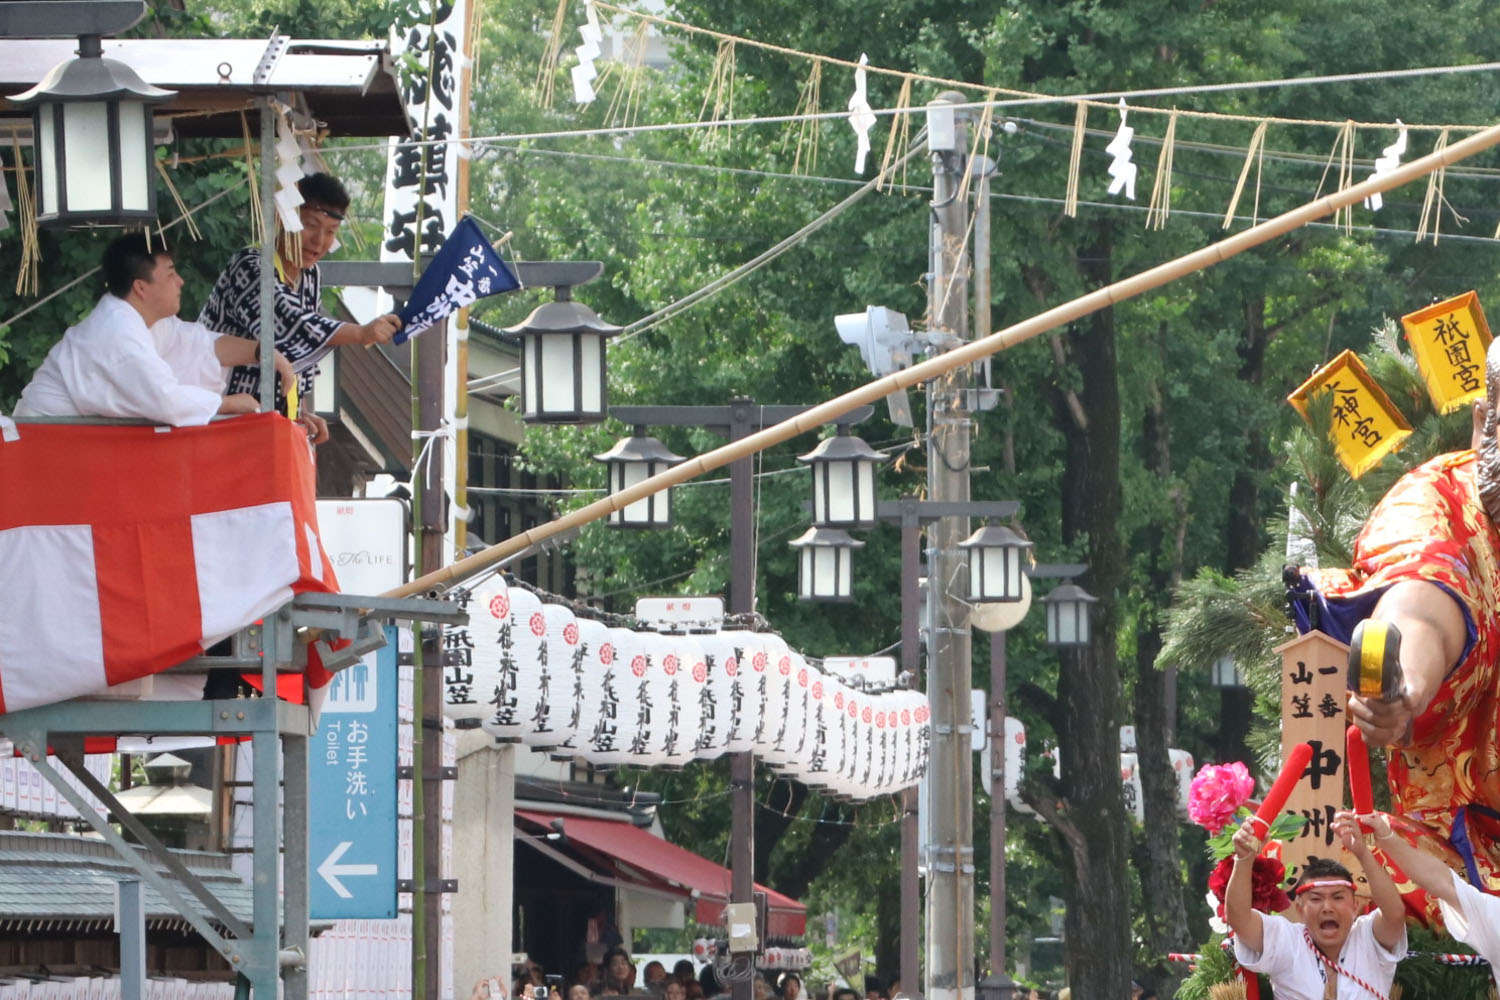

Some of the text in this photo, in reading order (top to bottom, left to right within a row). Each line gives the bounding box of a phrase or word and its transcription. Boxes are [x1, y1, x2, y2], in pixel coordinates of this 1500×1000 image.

[1290, 661, 1314, 719] 山笠
[1318, 665, 1343, 719] 一番
[326, 720, 341, 766] Toilet
[346, 720, 368, 820] お手洗い
[1287, 739, 1342, 901] 中洲
